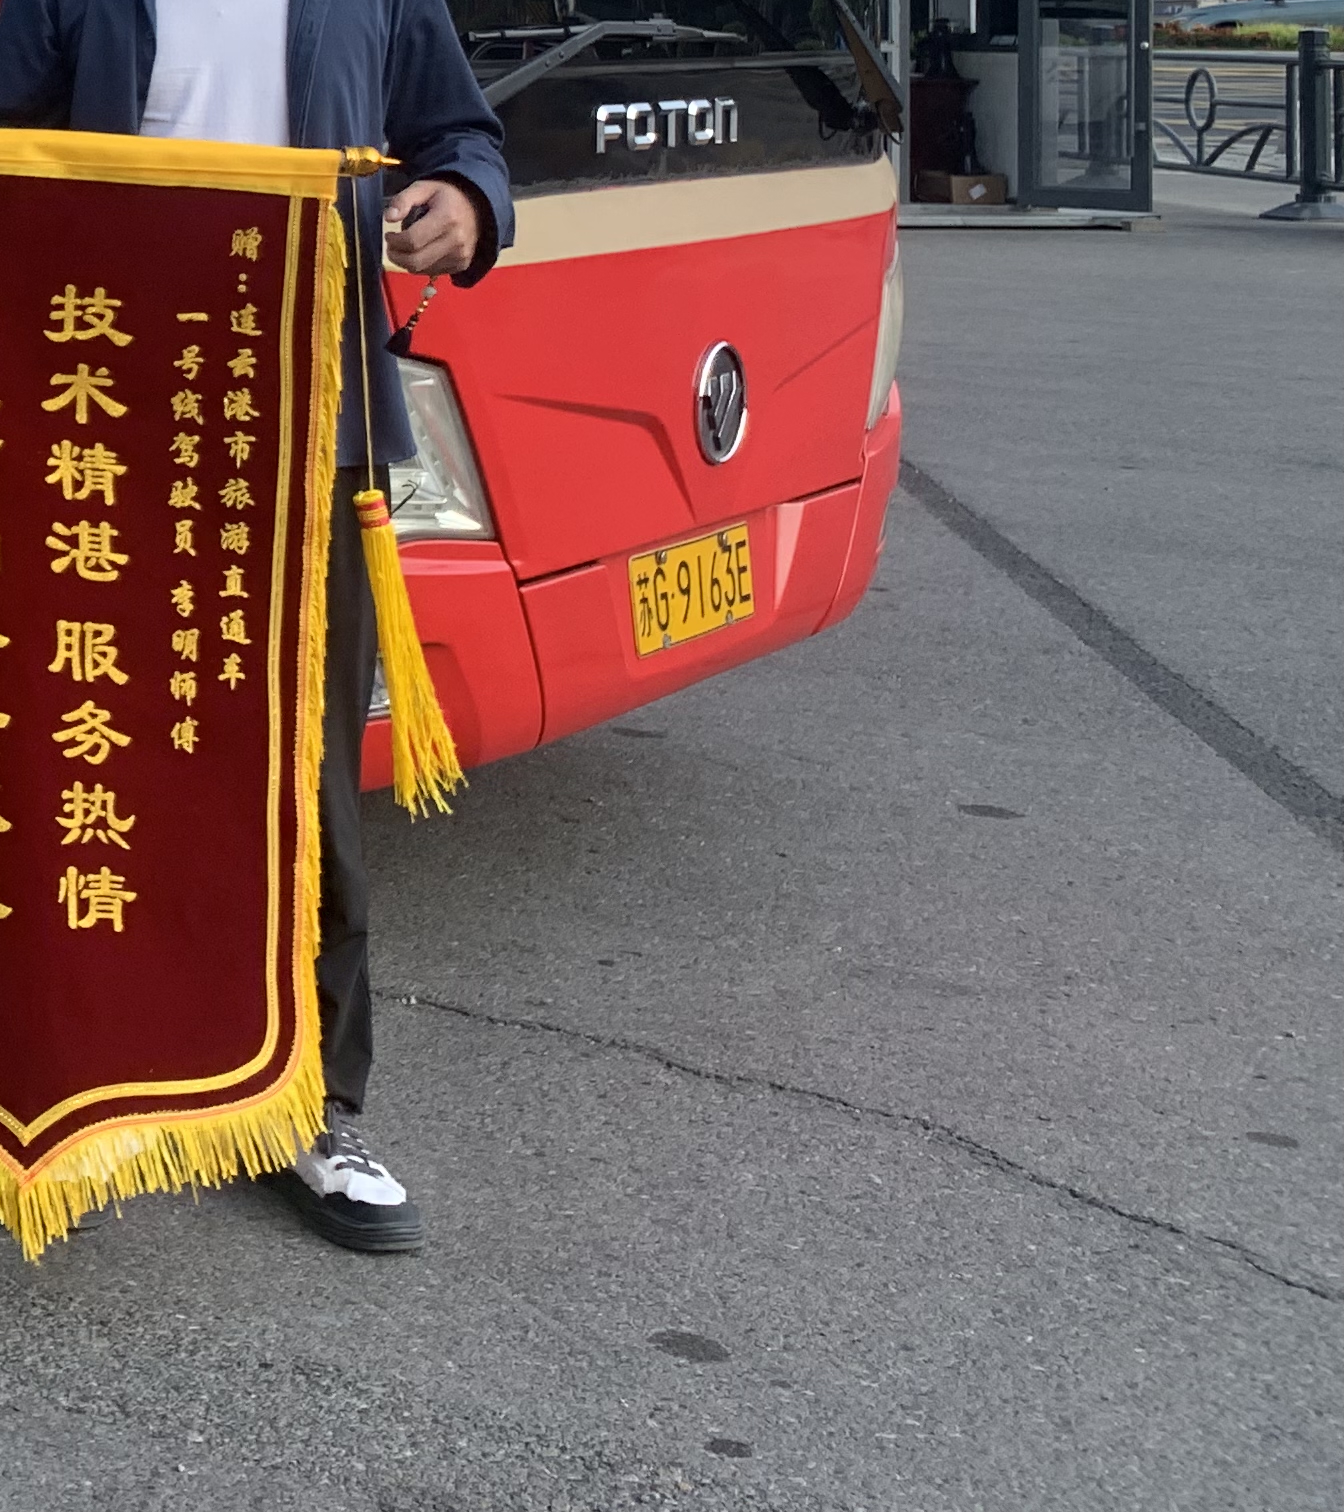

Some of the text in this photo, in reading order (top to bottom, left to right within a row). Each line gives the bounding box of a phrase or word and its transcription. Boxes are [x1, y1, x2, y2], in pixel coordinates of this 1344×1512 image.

[41, 284, 137, 933] 技术精湛 服务热情
